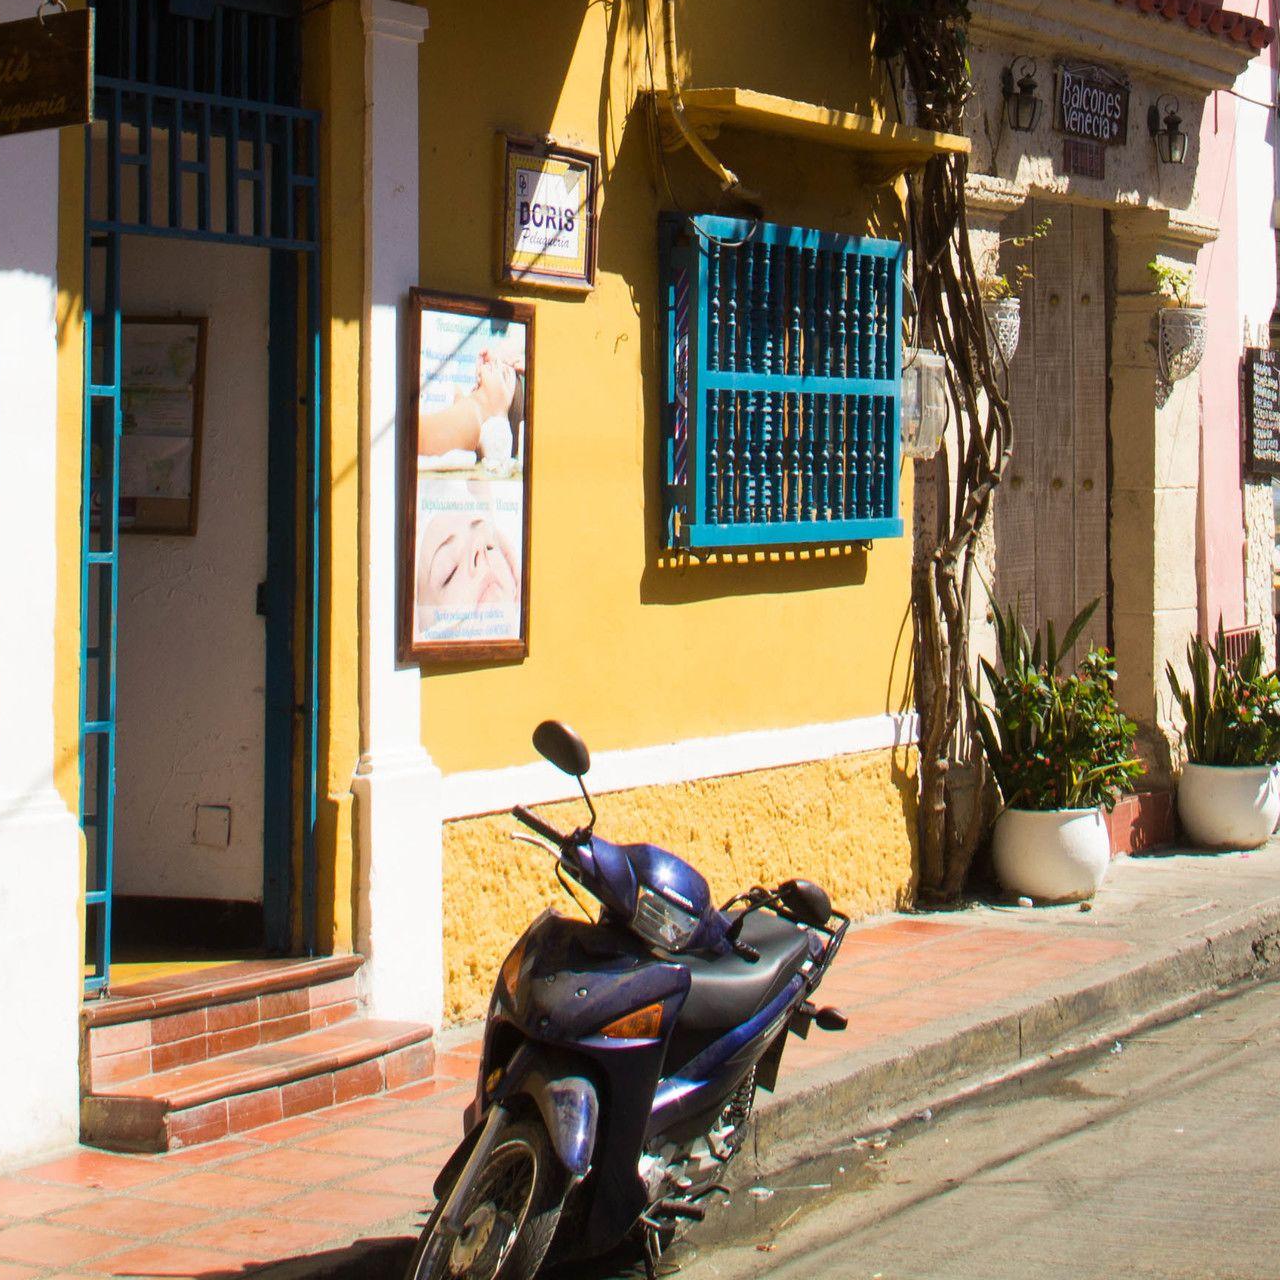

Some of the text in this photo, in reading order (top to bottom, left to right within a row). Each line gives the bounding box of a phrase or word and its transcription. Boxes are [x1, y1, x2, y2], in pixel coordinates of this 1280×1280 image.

[1062, 70, 1121, 118] Balcones
[1063, 104, 1110, 139] Venecia
[520, 201, 575, 232] DORIS
